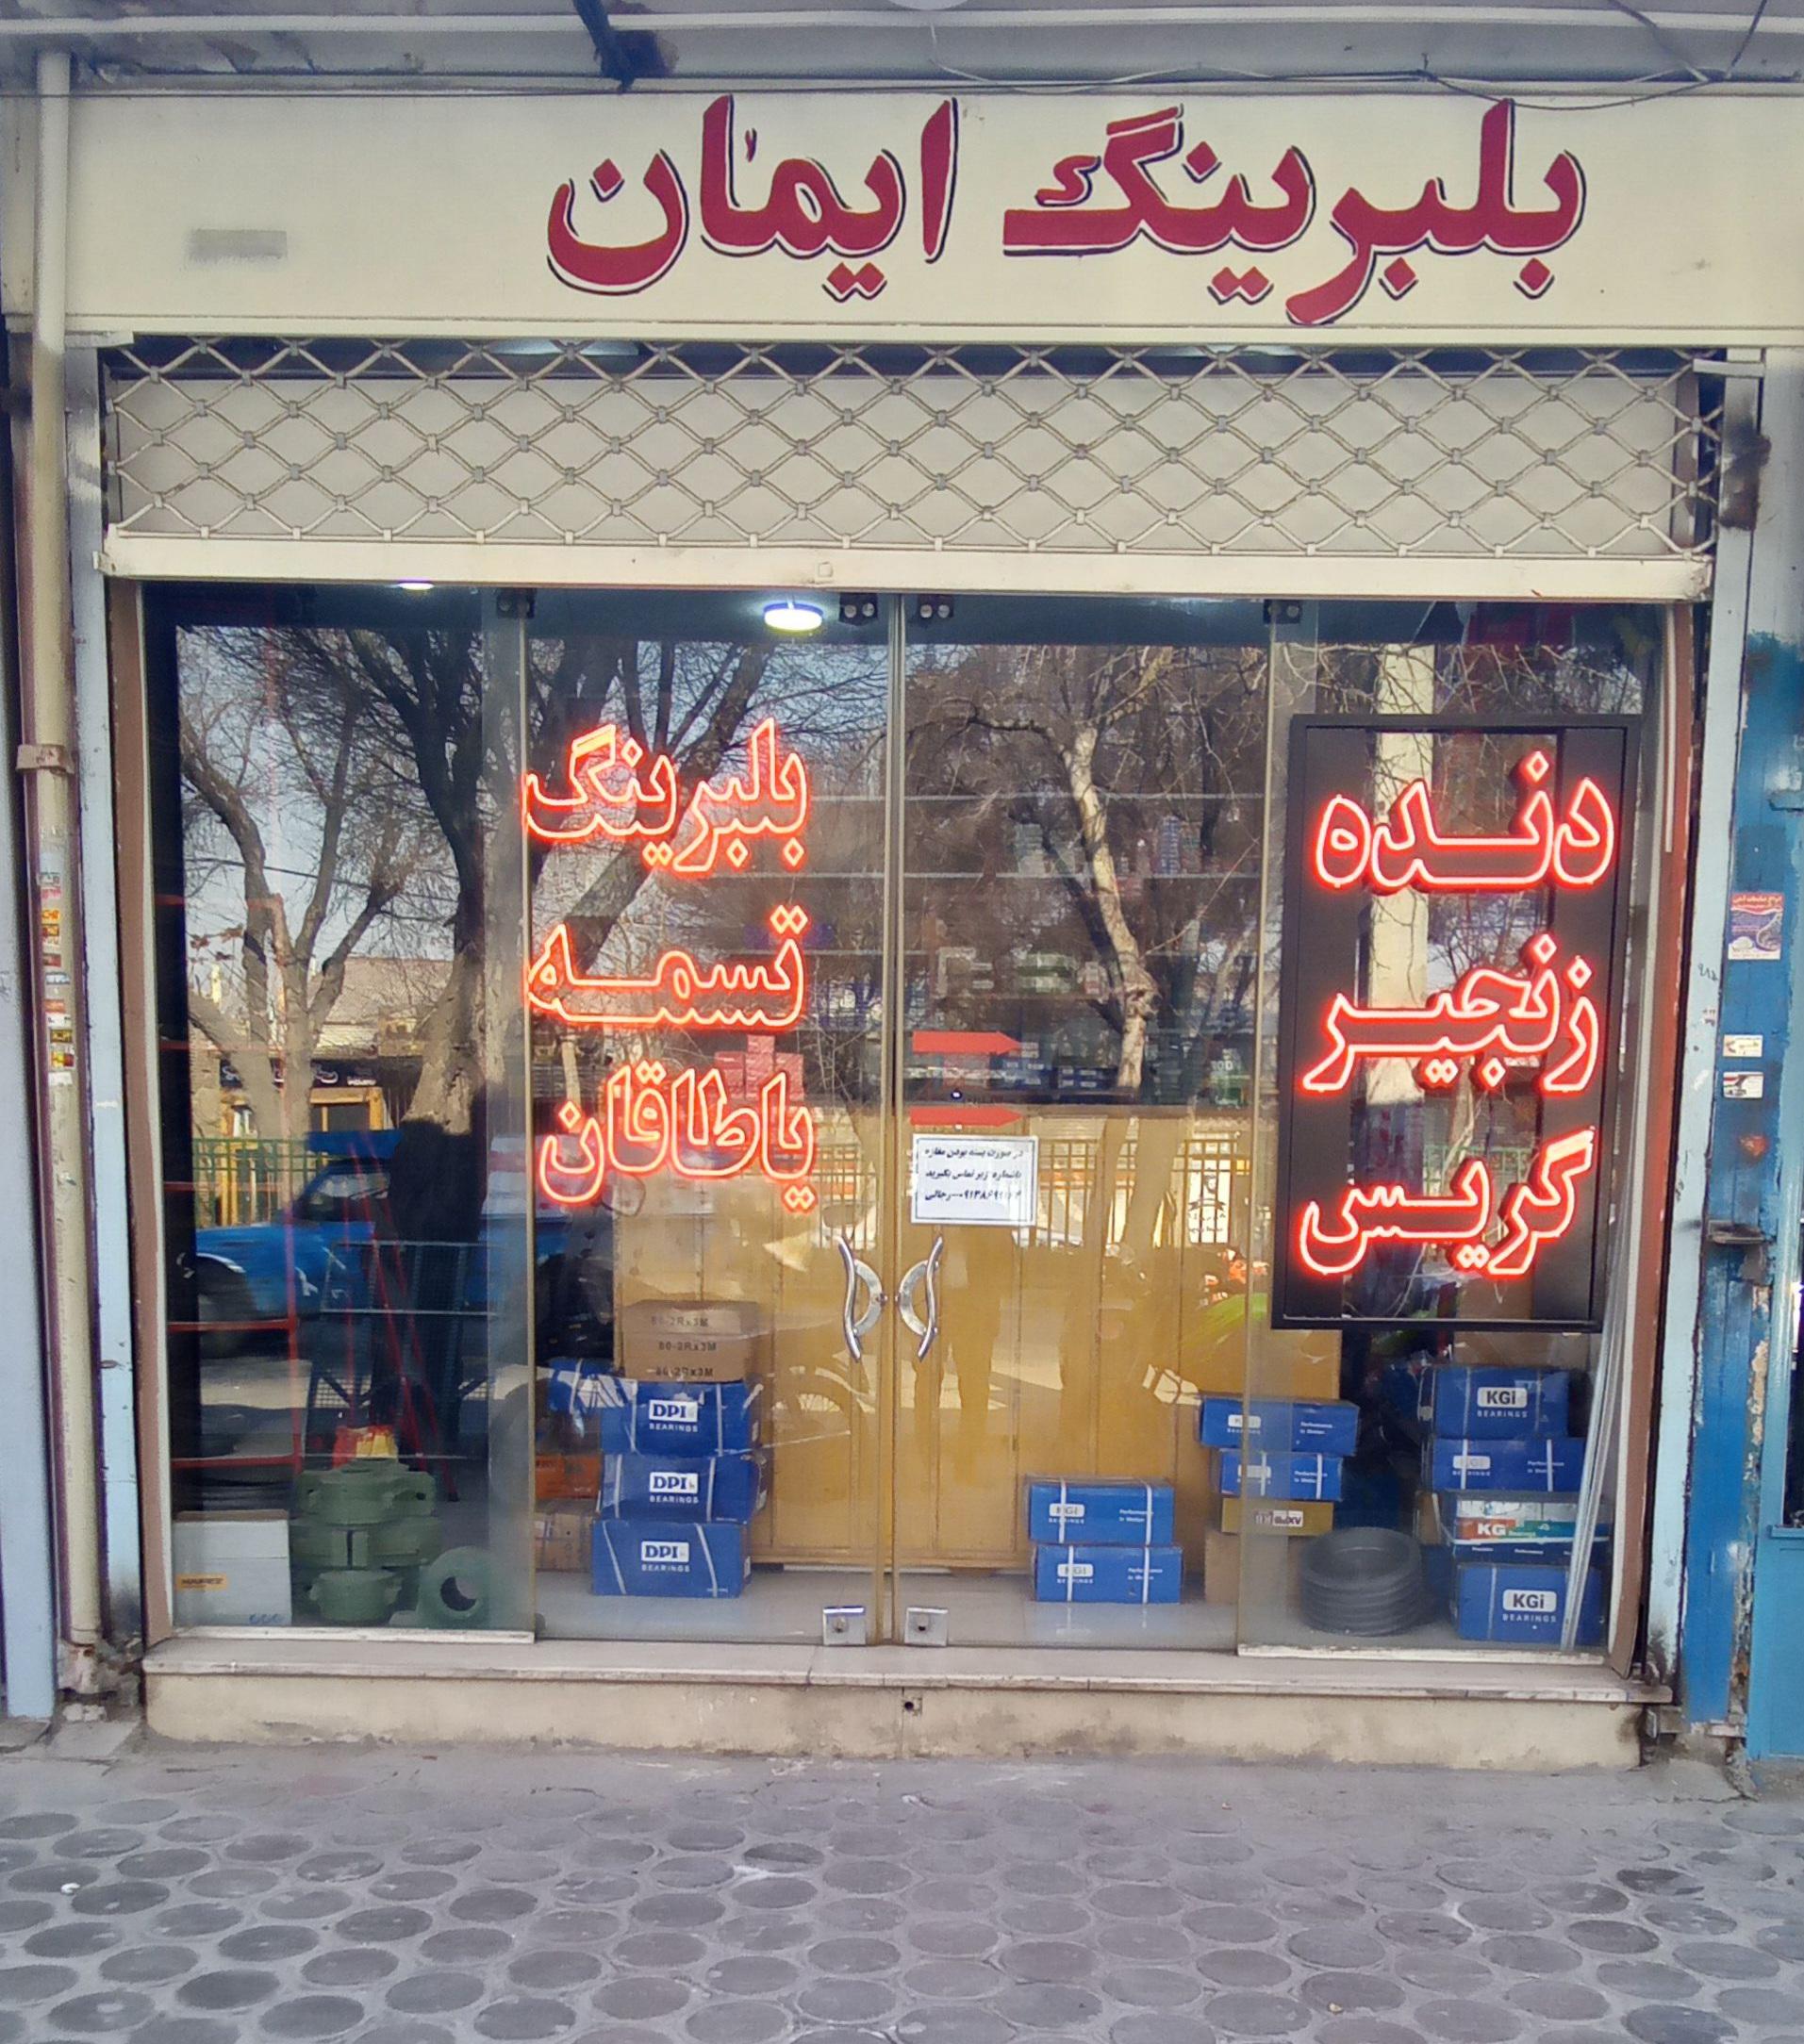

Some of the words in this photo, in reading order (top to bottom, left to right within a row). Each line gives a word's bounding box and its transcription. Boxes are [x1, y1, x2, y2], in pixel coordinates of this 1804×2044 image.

[546, 93, 959, 303] ایمان
[1002, 97, 1587, 326] بلبرینگ
[522, 717, 809, 873] بلبرینگ
[1315, 750, 1615, 890] دنده
[525, 904, 809, 1028] تسمه
[1300, 932, 1601, 1094] زنجیر
[538, 1061, 817, 1211] یاطاقان
[1299, 1127, 1597, 1276] گریس
[653, 1403, 687, 1418] DPI
[1477, 1409, 1528, 1418] BEARINGS
[649, 1423, 699, 1432] BEARINGS
[653, 1475, 687, 1490] DPI
[649, 1494, 700, 1504] BEARINGS
[645, 1544, 679, 1559] DPI
[641, 1563, 691, 1573] BEARINGS
[1513, 1592, 1545, 1608] KGi
[1502, 1613, 1557, 1623] BEARINGS
